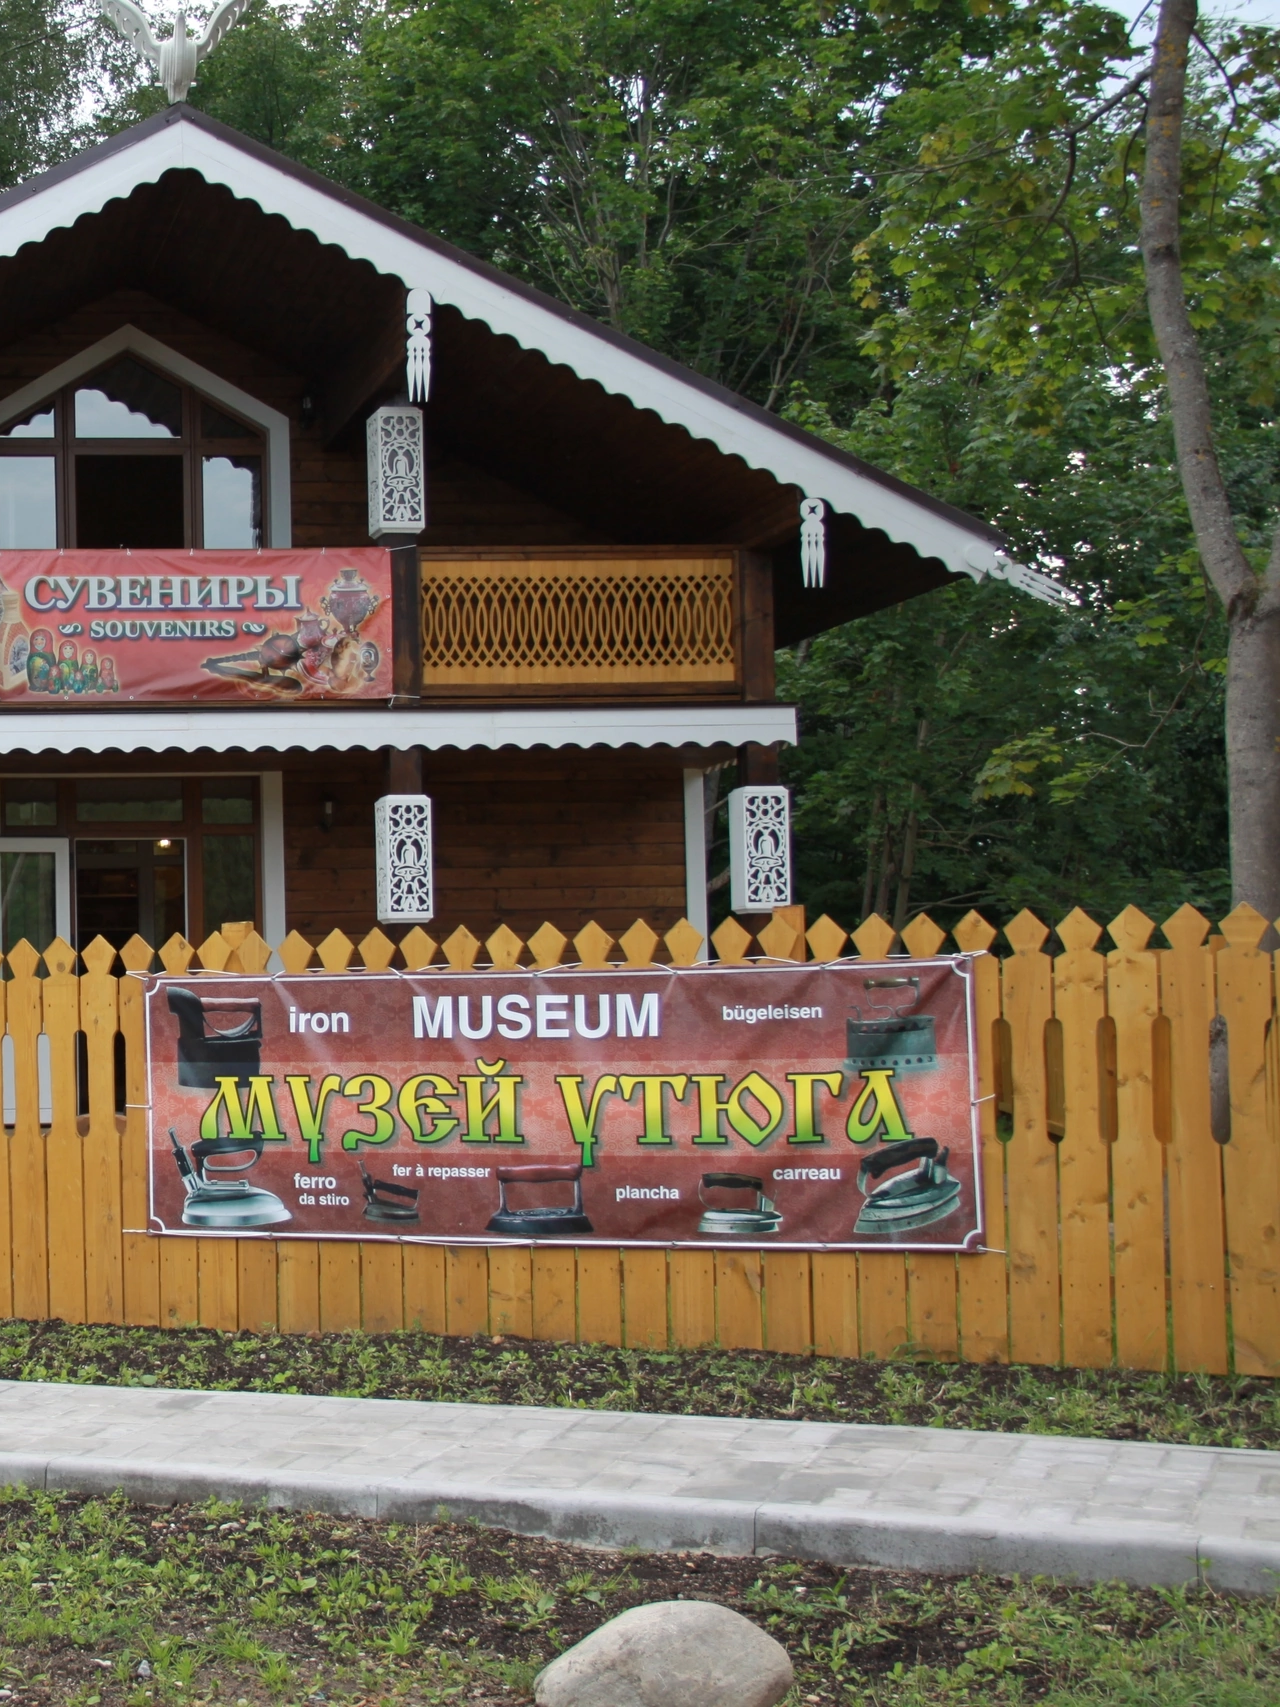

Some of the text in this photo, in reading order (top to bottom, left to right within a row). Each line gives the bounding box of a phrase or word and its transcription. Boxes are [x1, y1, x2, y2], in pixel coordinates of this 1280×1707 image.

[24, 574, 302, 611] СУВЕНИРЫ
[89, 619, 236, 639] SOUVENIRS
[289, 1006, 349, 1033] iron
[412, 993, 660, 1040] MUSEUM
[722, 1004, 822, 1024] bügeleisen
[199, 1056, 916, 1168] МУЗЕЙ УТЮГА
[294, 1172, 336, 1189] ferro
[392, 1163, 490, 1180] fer à repasser
[773, 1165, 841, 1180] carreau
[299, 1192, 349, 1206] da stiro
[615, 1184, 679, 1201] plancha
